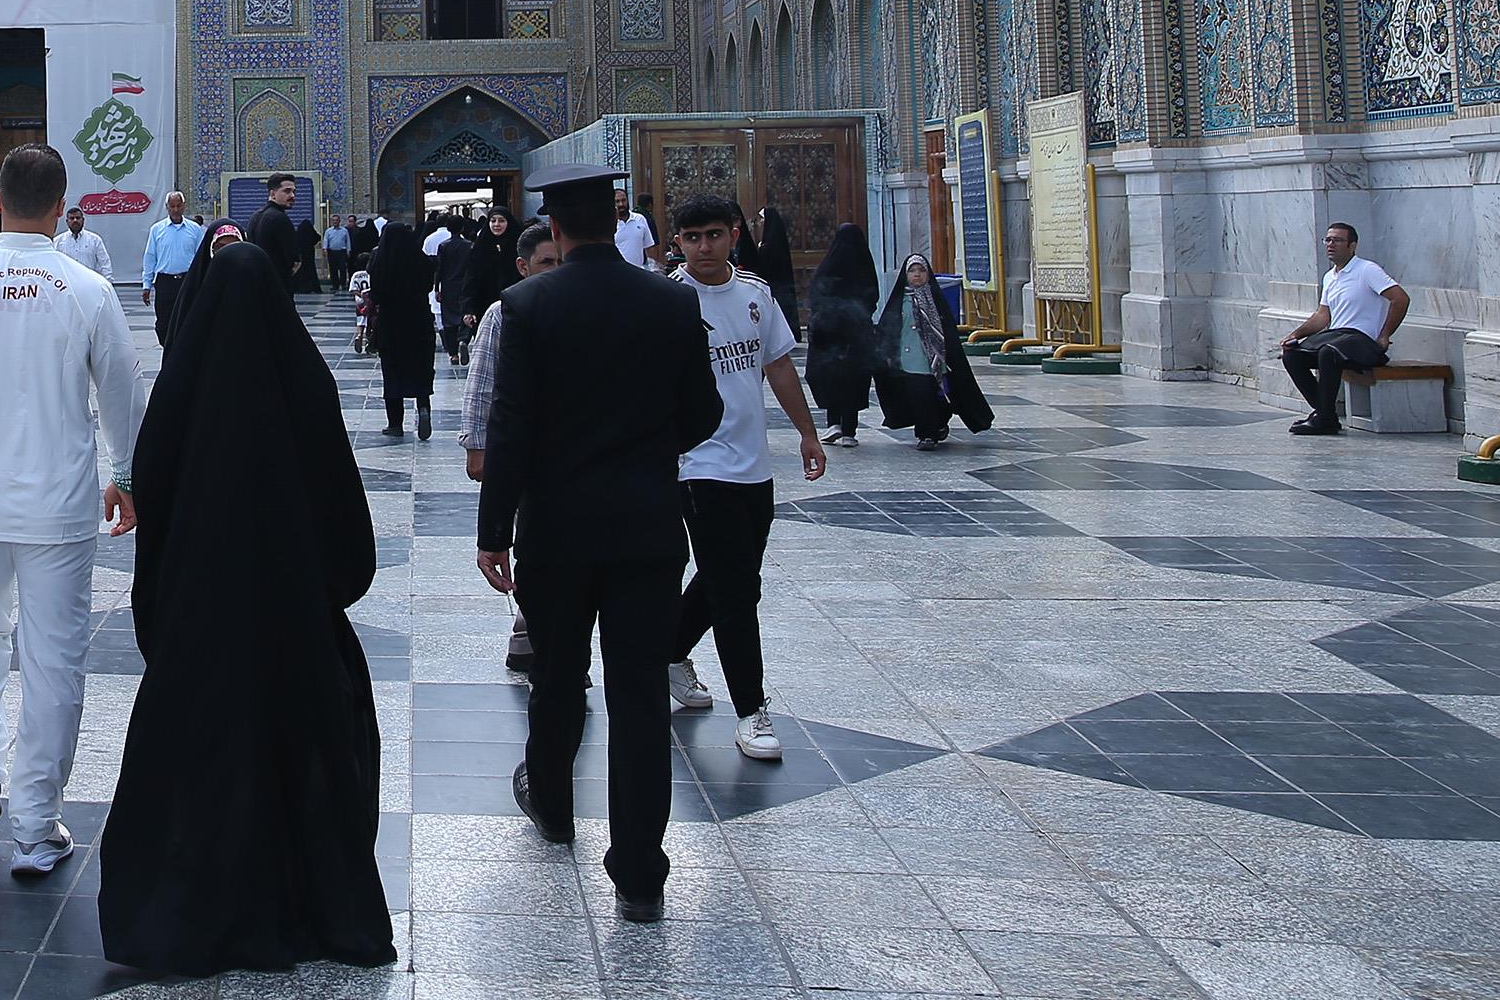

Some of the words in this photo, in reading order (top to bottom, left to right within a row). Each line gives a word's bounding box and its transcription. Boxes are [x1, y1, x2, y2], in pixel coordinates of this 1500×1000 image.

[7, 267, 54, 281] Republic
[54, 280, 68, 293] Of
[2, 284, 38, 300] IRAN
